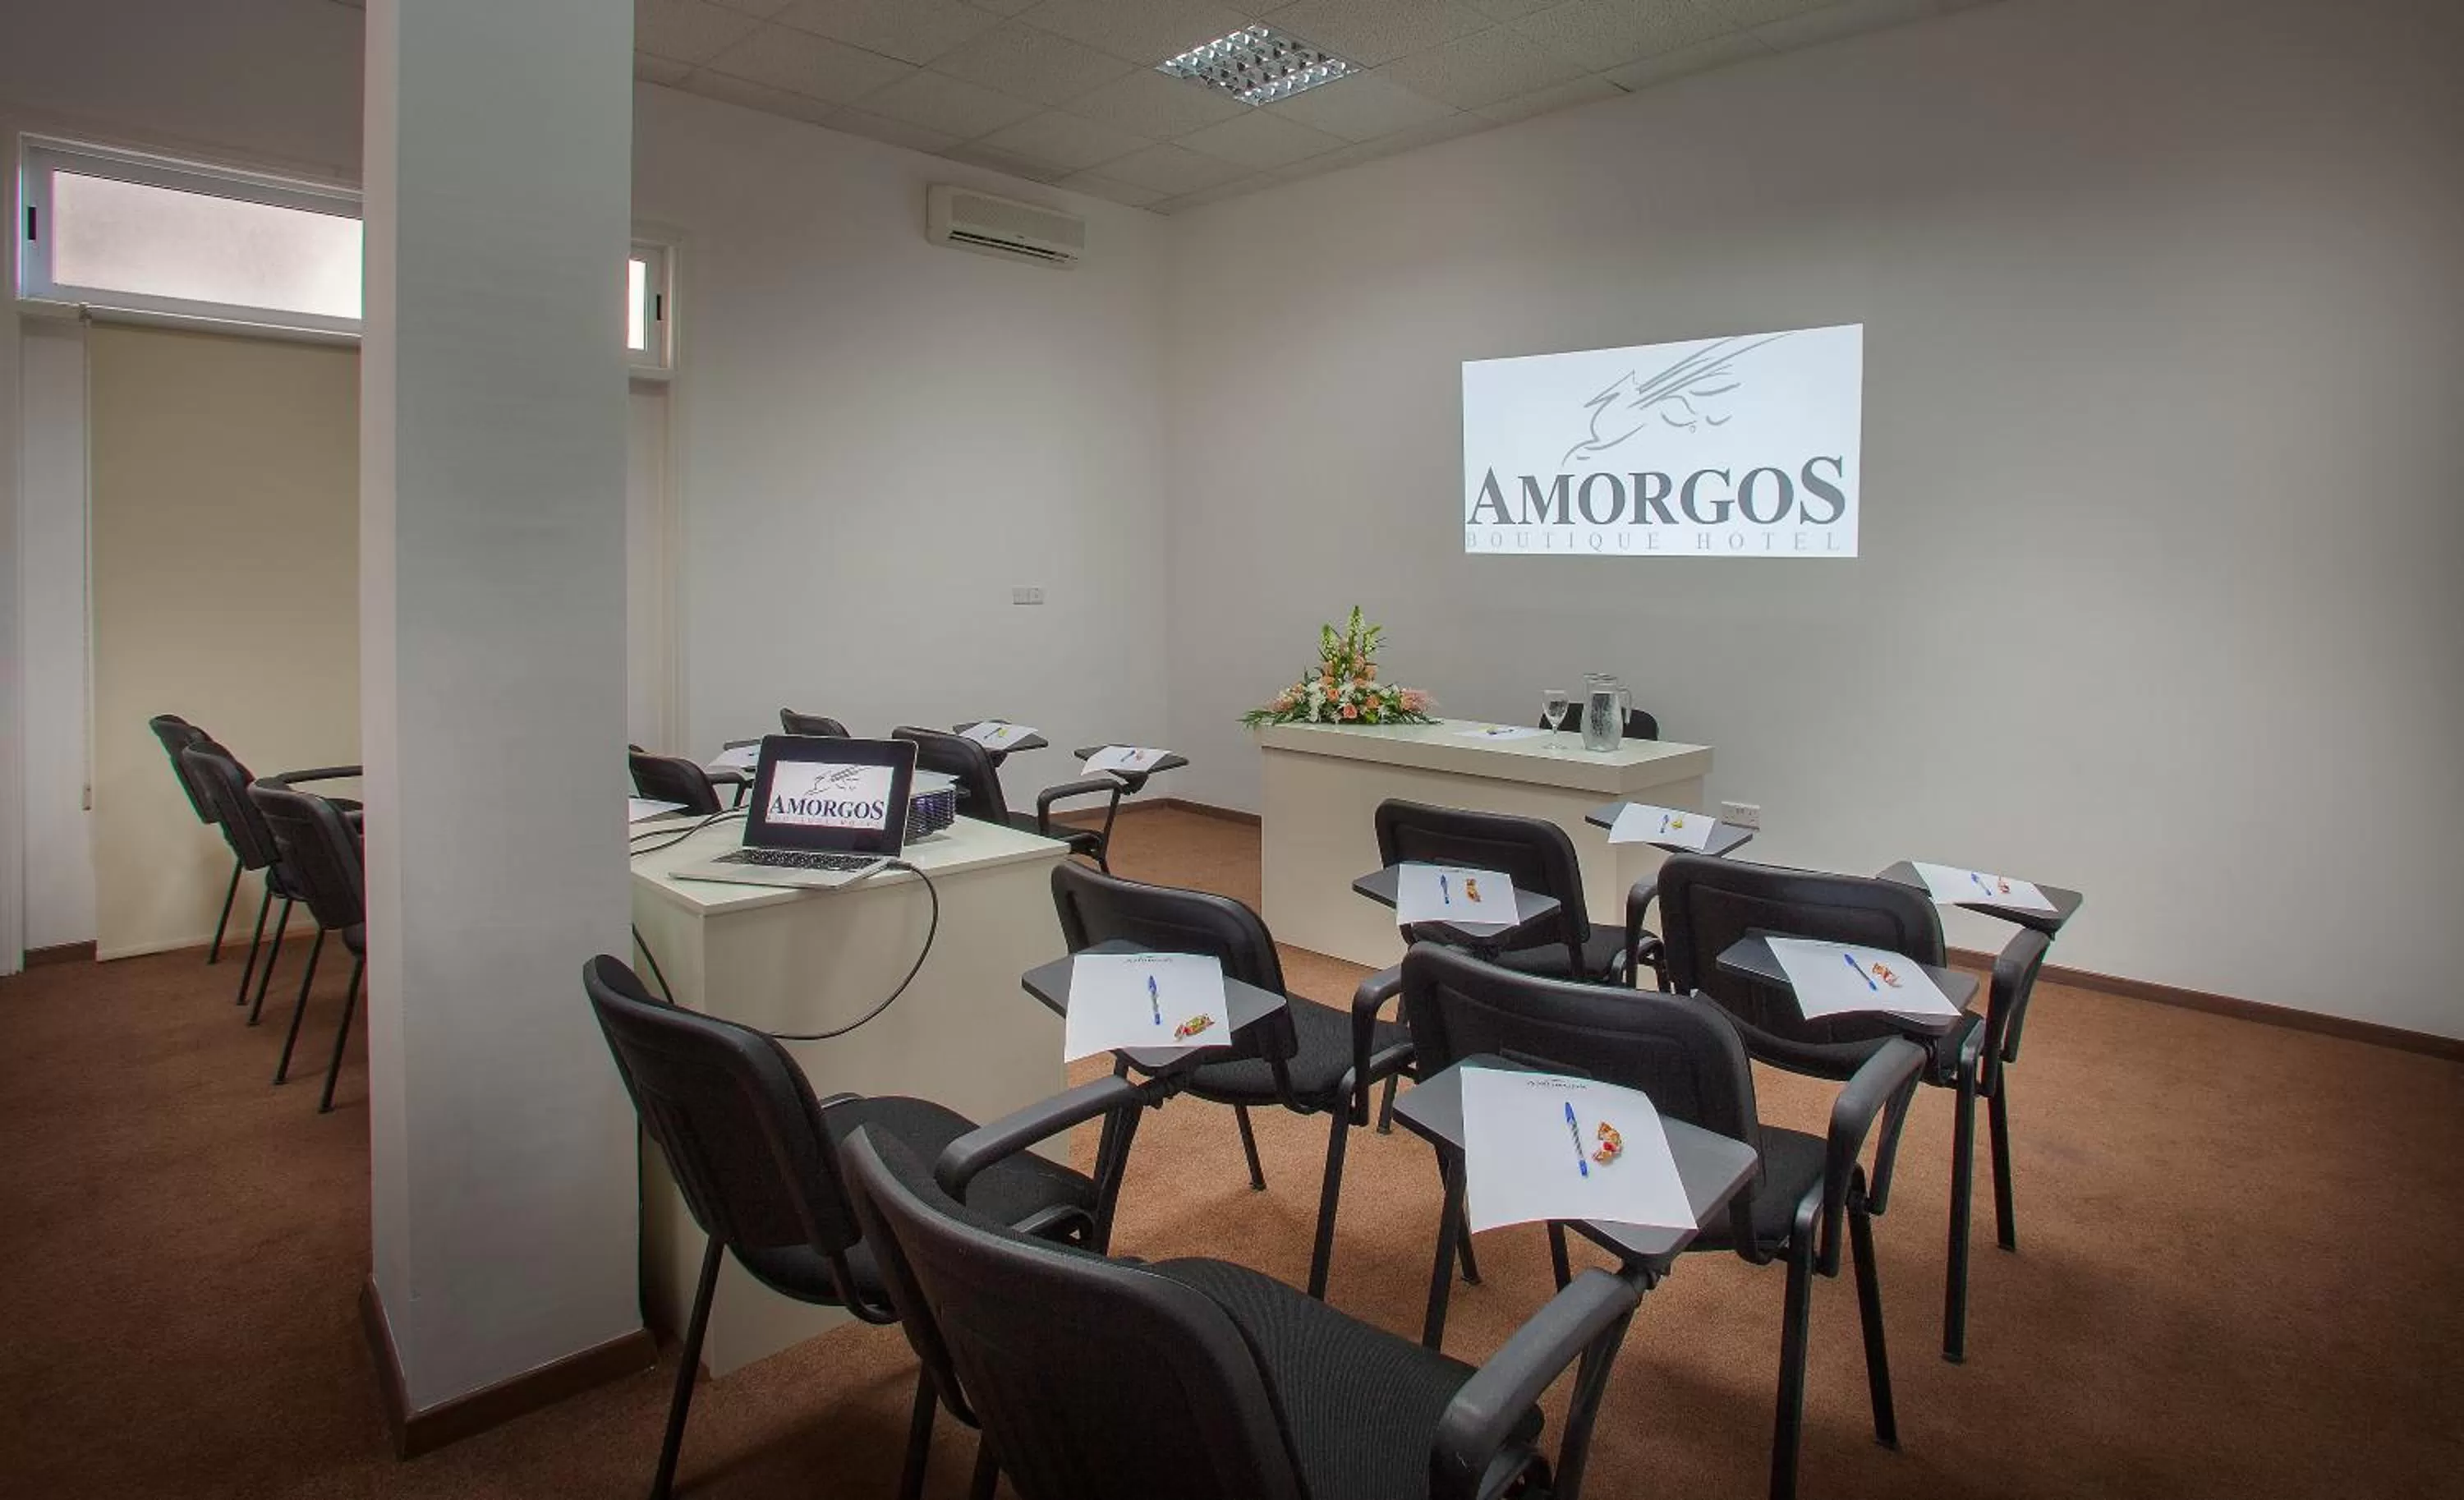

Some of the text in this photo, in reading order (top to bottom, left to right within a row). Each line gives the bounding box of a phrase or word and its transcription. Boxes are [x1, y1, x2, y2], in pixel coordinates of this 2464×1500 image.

[1466, 454, 1846, 526] AMORGOS
[1466, 531, 1841, 552] BOUTIQUE HOTEL
[769, 794, 885, 821] AMORGOS
